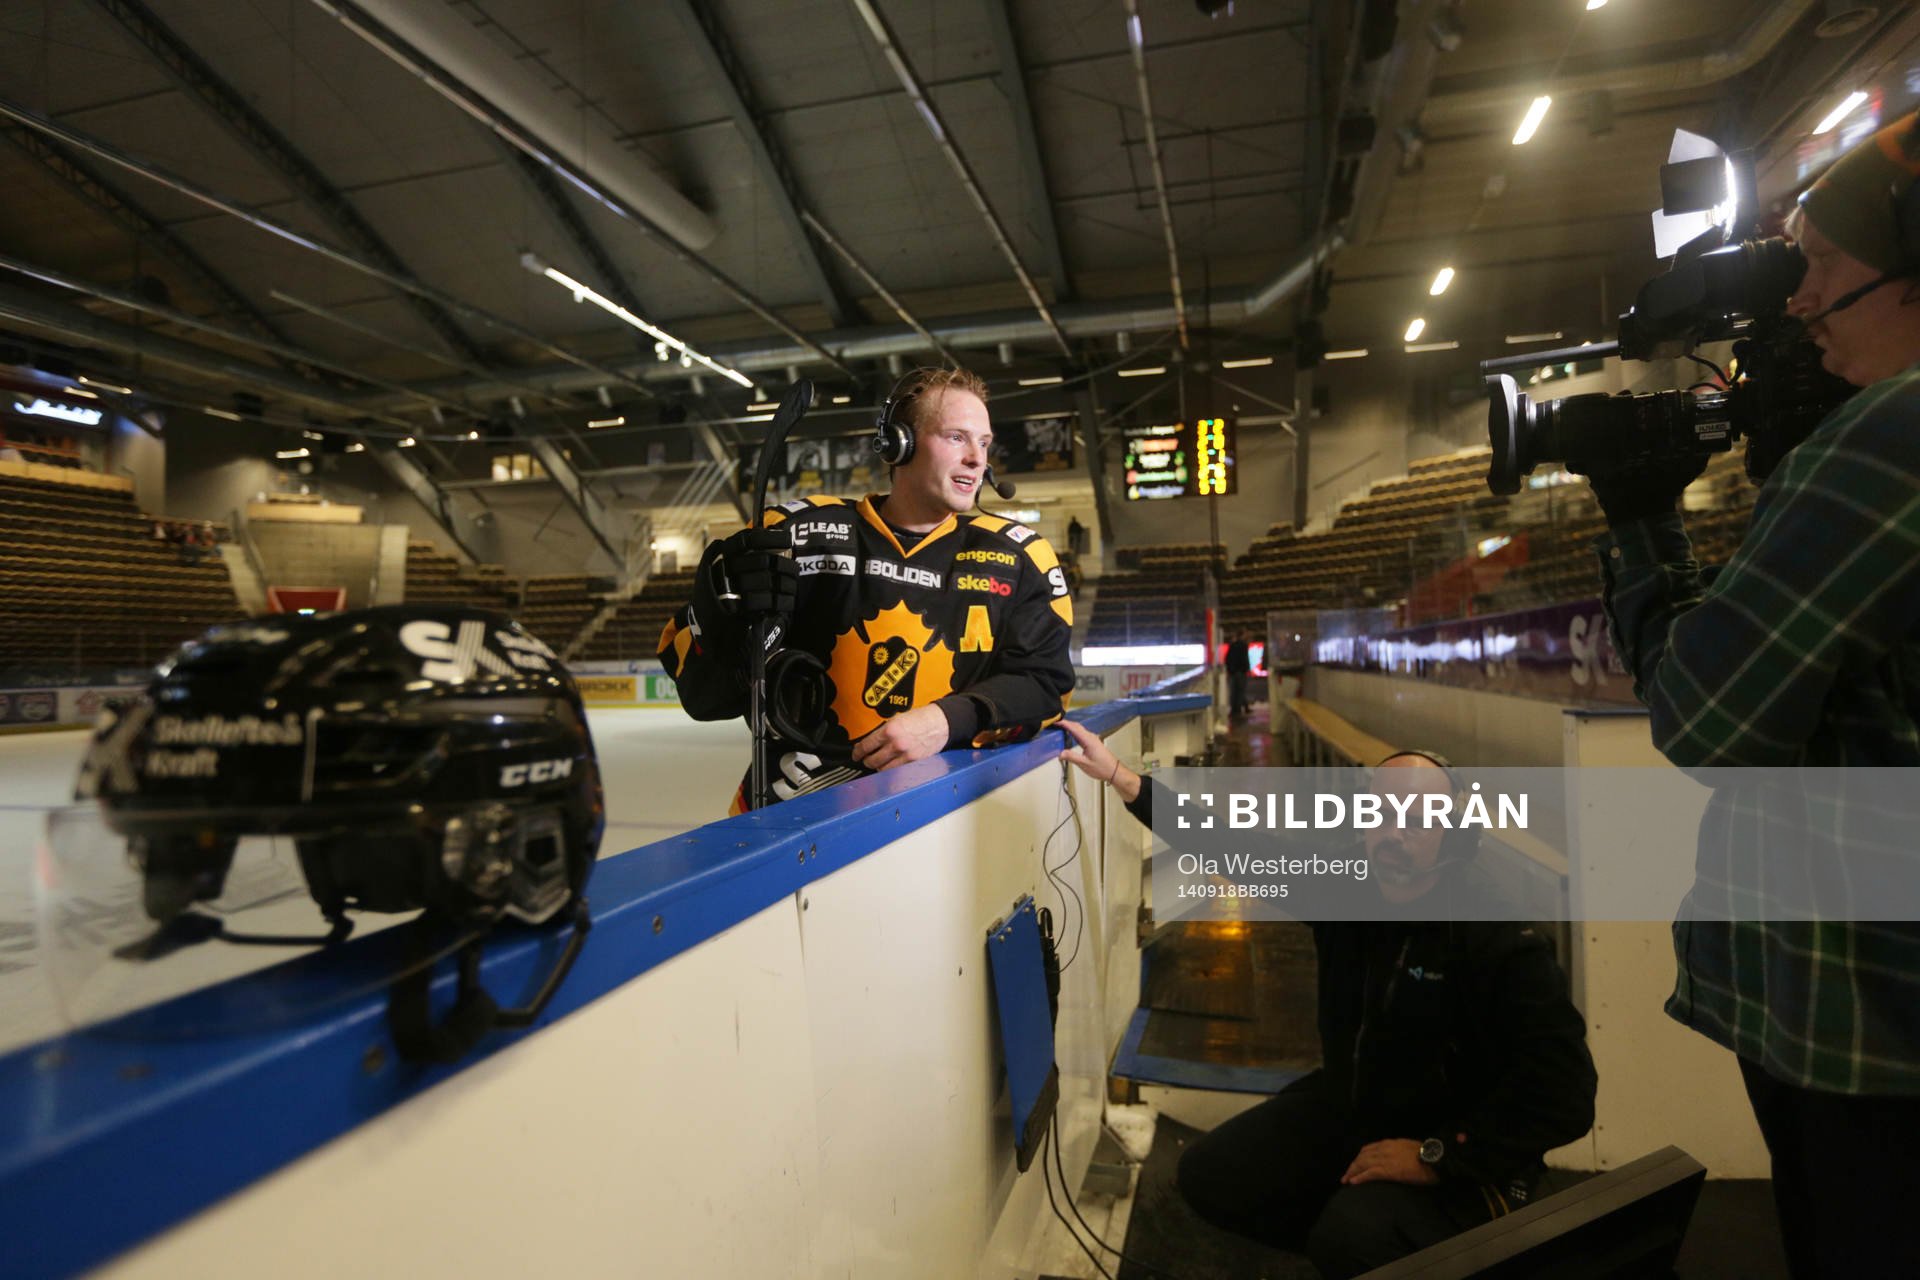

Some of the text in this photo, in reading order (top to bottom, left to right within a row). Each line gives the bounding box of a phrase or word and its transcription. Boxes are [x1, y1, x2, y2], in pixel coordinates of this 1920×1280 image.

[809, 522, 849, 534] LEAB
[826, 533, 849, 541] group
[956, 550, 1015, 566] engcon
[868, 559, 942, 589] BOLIDEN
[957, 574, 1011, 596] skebo
[960, 605, 994, 652] A
[889, 694, 909, 706] 1921
[500, 758, 573, 788] CCM
